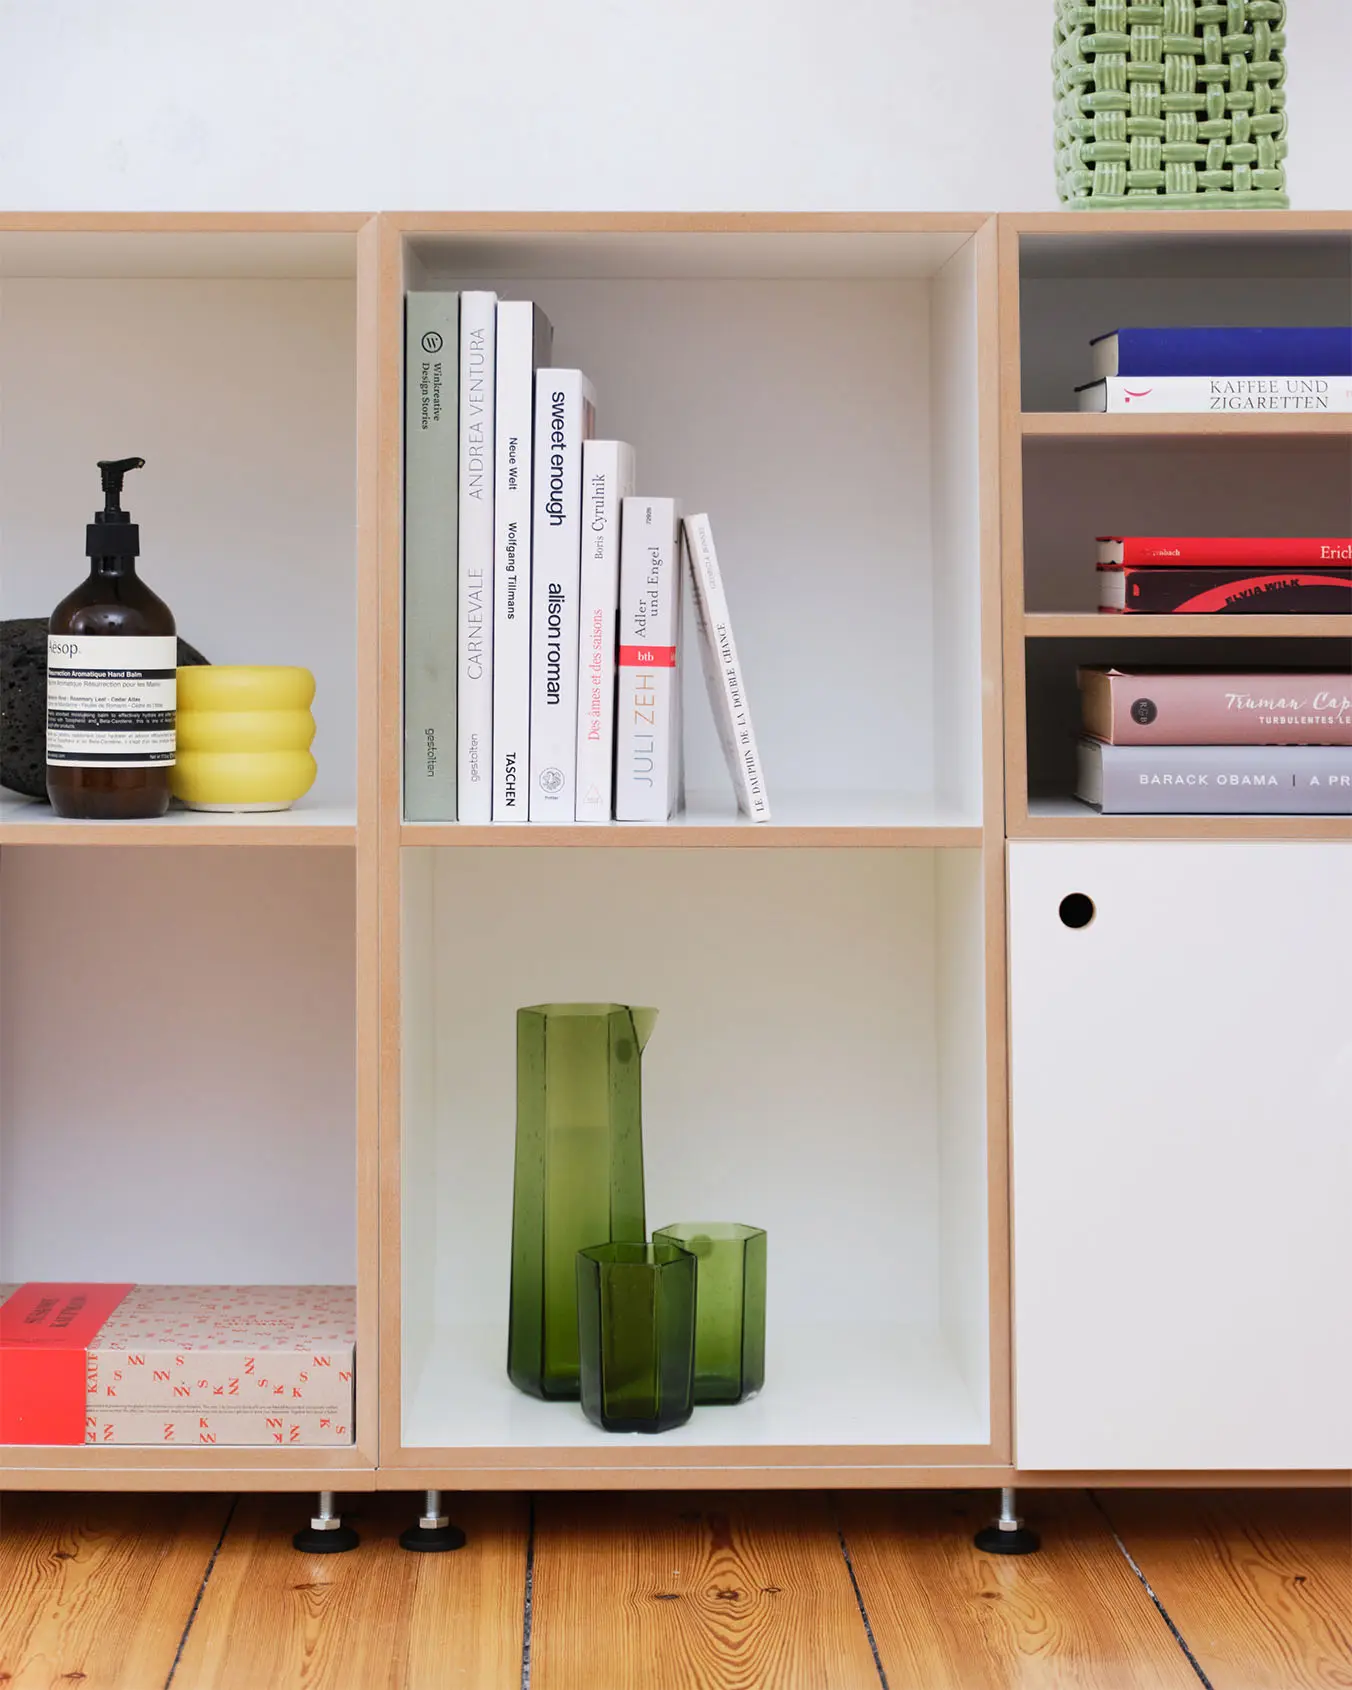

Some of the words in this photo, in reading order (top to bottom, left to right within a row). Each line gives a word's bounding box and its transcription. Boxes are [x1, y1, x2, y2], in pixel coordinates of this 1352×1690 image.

[420, 362, 430, 395] Design
[469, 328, 484, 416] VENTURA
[1210, 380, 1279, 393] KAFFEE
[1286, 380, 1328, 393] UND
[433, 362, 442, 421] Winkreative
[1210, 396, 1329, 409] ZIGARETTEN
[421, 397, 430, 430] Stories
[551, 391, 567, 450] sweet
[469, 422, 484, 500] ANDREA
[508, 437, 518, 464] Neue
[508, 467, 517, 490] Welt
[545, 454, 566, 526] enough
[591, 474, 607, 531] Cyrulnik
[506, 522, 518, 572] Wolfgang
[593, 535, 604, 559] Boris
[647, 546, 663, 584] Engel
[507, 575, 517, 620] Tillmans
[1263, 578, 1301, 592] WILK
[548, 582, 565, 638] alison
[634, 599, 647, 638] Adler
[647, 590, 659, 617] und
[468, 568, 483, 679] CARNEVALE
[588, 608, 602, 649] saisons
[637, 651, 654, 661] btb
[716, 623, 732, 664] CHANCE
[71, 670, 107, 679] Aromatique
[547, 643, 561, 705] roman
[588, 652, 601, 671] des
[588, 675, 601, 685] et
[729, 668, 742, 708] DOUBLE
[635, 675, 656, 725] ZEH
[1225, 692, 1308, 710] Truman
[587, 720, 600, 740] Des
[737, 712, 746, 726] LA
[1259, 716, 1334, 724] TURBULENTES
[741, 731, 750, 745] DE
[633, 734, 654, 787] JULI
[744, 750, 761, 794] DAUPHIN
[505, 752, 516, 807] TASCHEN
[1139, 774, 1209, 785] BARACK
[1216, 774, 1279, 786] OBAMA
[1309, 775, 1320, 786] A
[757, 798, 765, 813] LE
